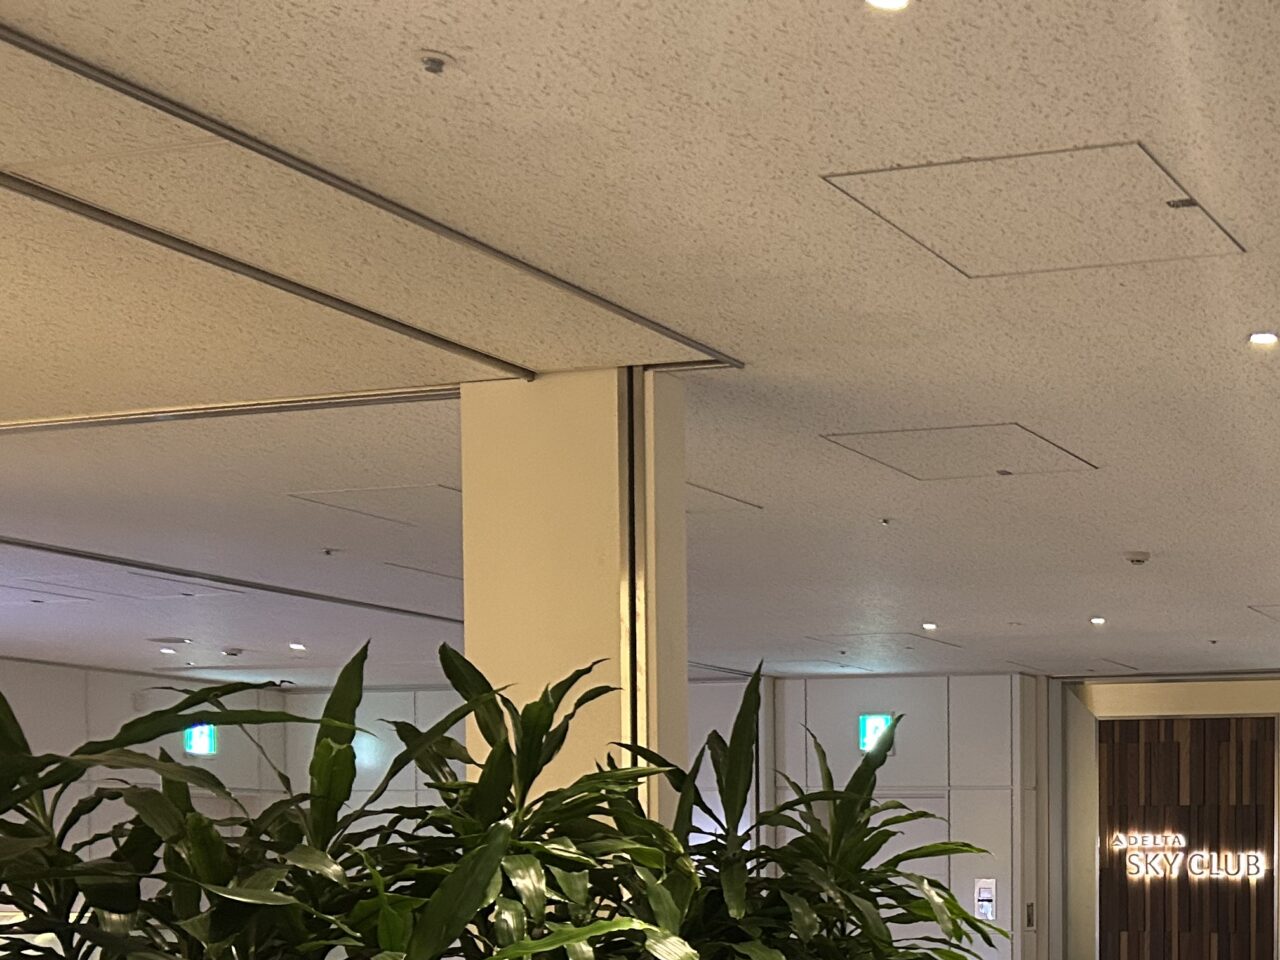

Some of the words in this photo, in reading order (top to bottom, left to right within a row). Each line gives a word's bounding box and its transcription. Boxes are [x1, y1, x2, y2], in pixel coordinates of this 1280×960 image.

[1128, 835, 1182, 846] DELTA
[1127, 853, 1181, 876] SKY
[1188, 853, 1261, 876] CLUB
